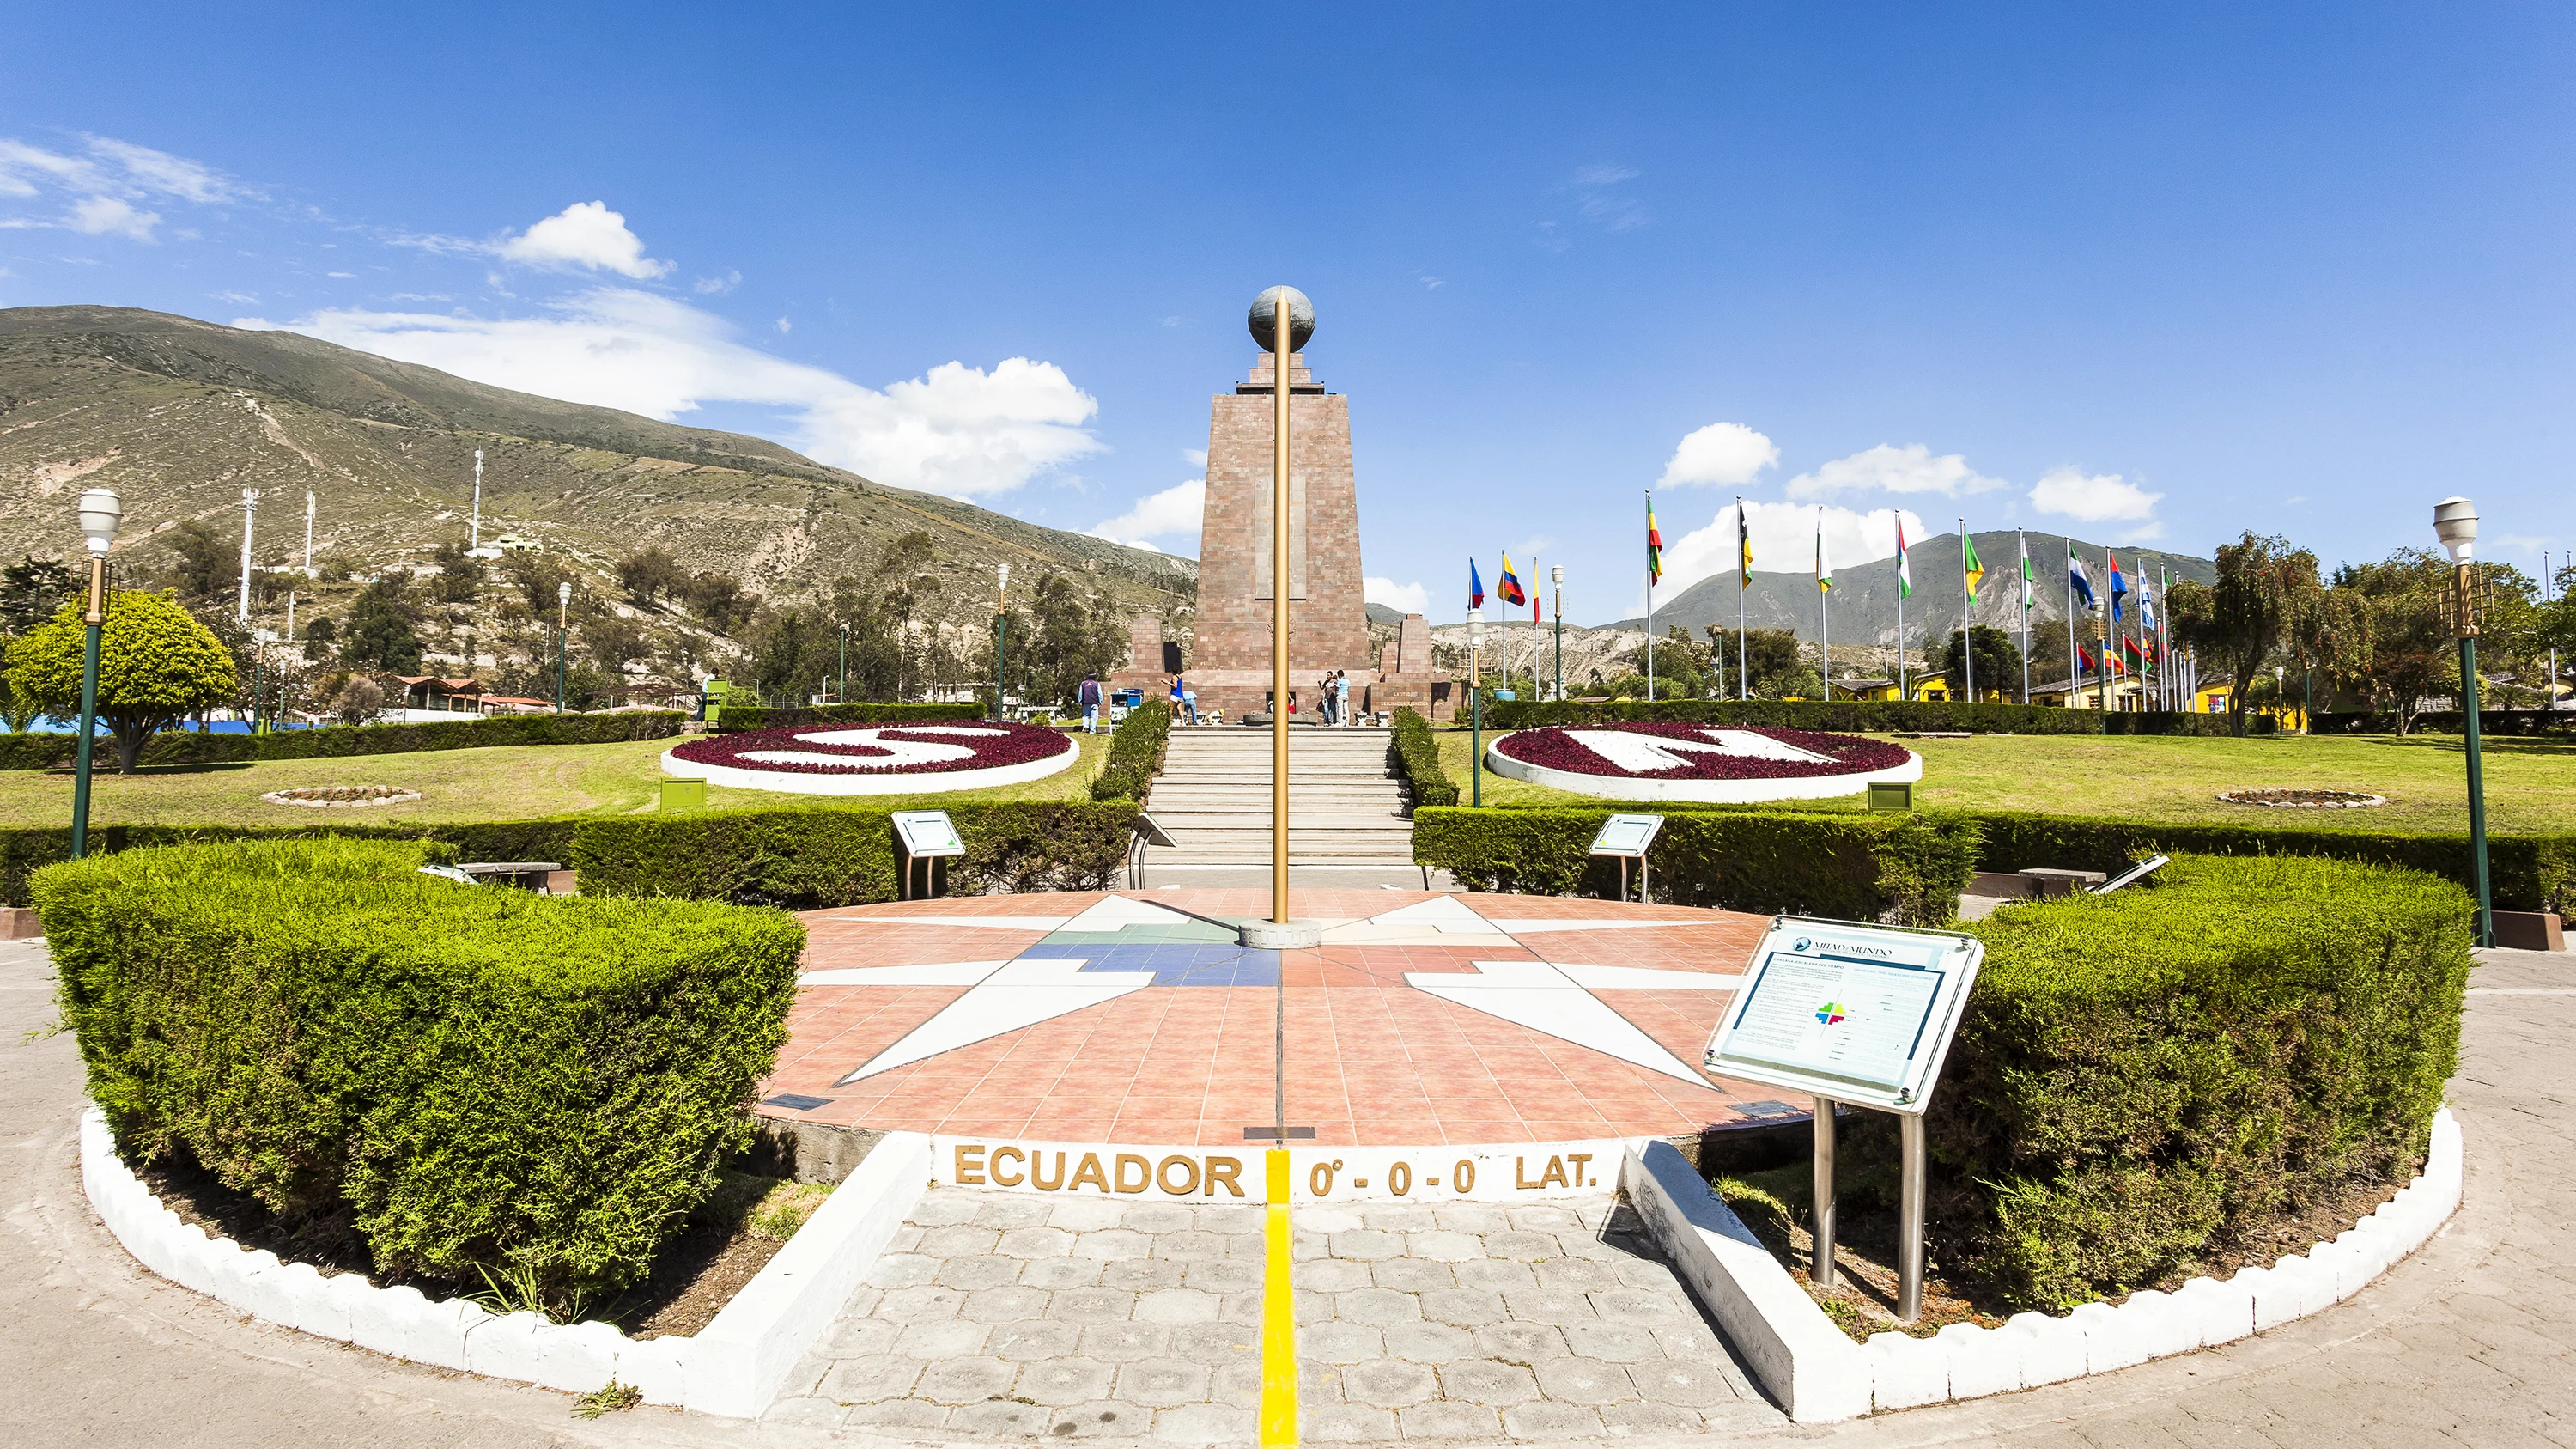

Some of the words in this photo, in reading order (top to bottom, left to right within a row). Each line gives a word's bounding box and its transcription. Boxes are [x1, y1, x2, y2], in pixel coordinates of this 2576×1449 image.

[1850, 946, 1893, 957] MUNDO
[954, 1144, 1245, 1197] ECUADOR
[1516, 1154, 1597, 1190] LAT.
